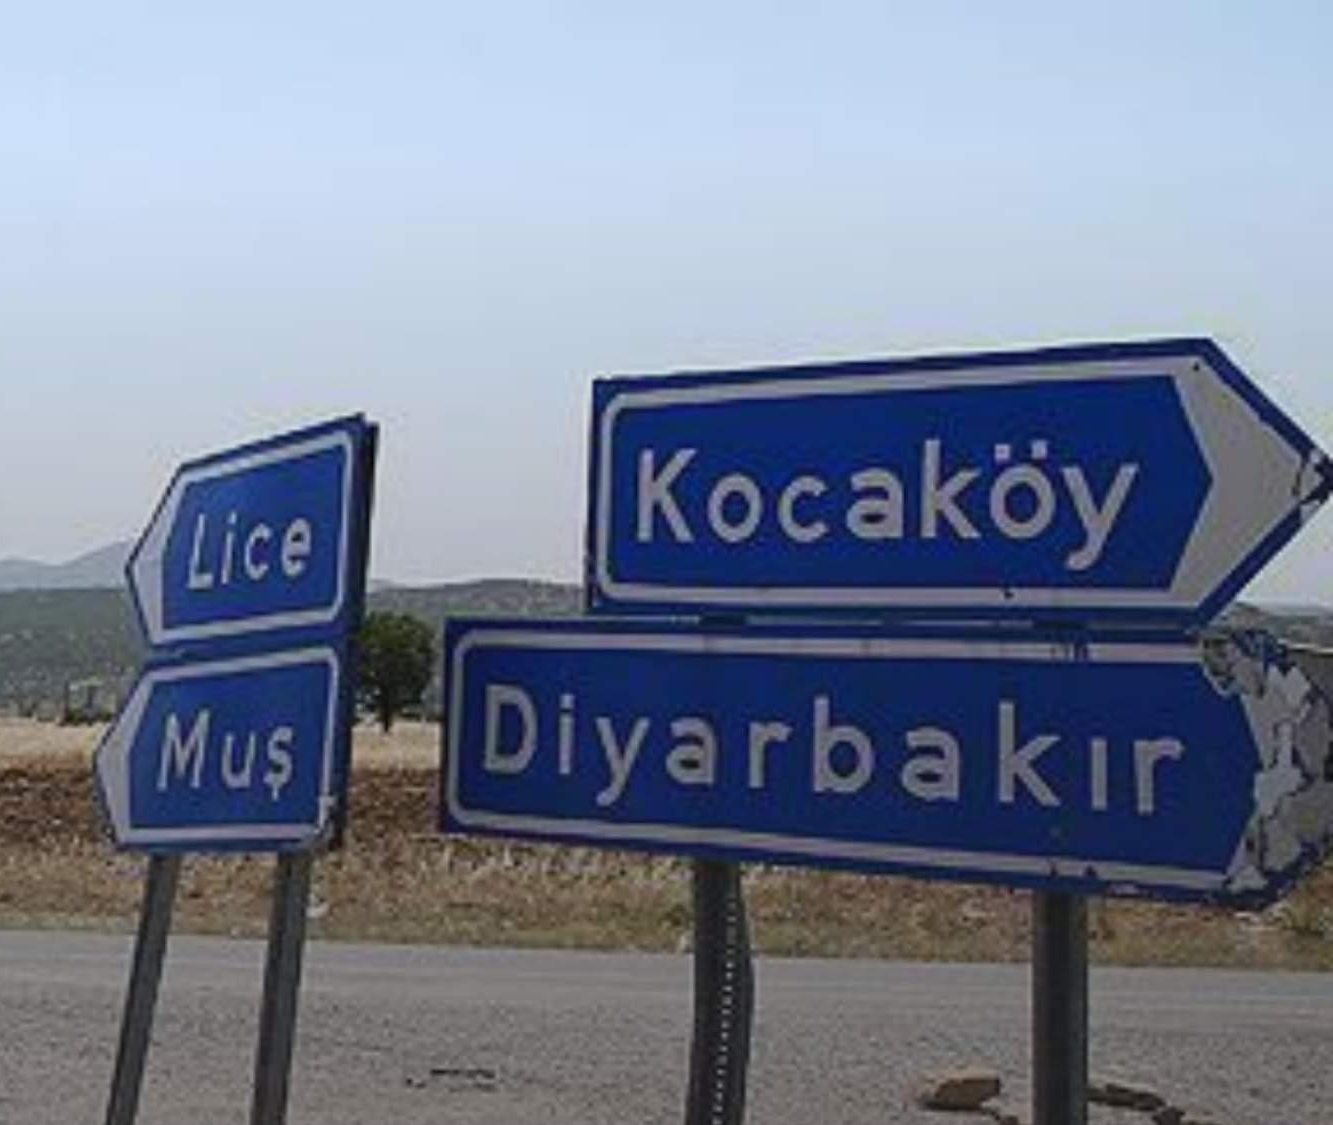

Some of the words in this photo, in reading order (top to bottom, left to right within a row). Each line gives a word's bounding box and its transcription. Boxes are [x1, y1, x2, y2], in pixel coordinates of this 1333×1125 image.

[185, 510, 313, 591] Lice
[636, 437, 1139, 571] Kocaköy
[156, 709, 294, 802] Muş
[482, 684, 1185, 815] Diyarbakır
